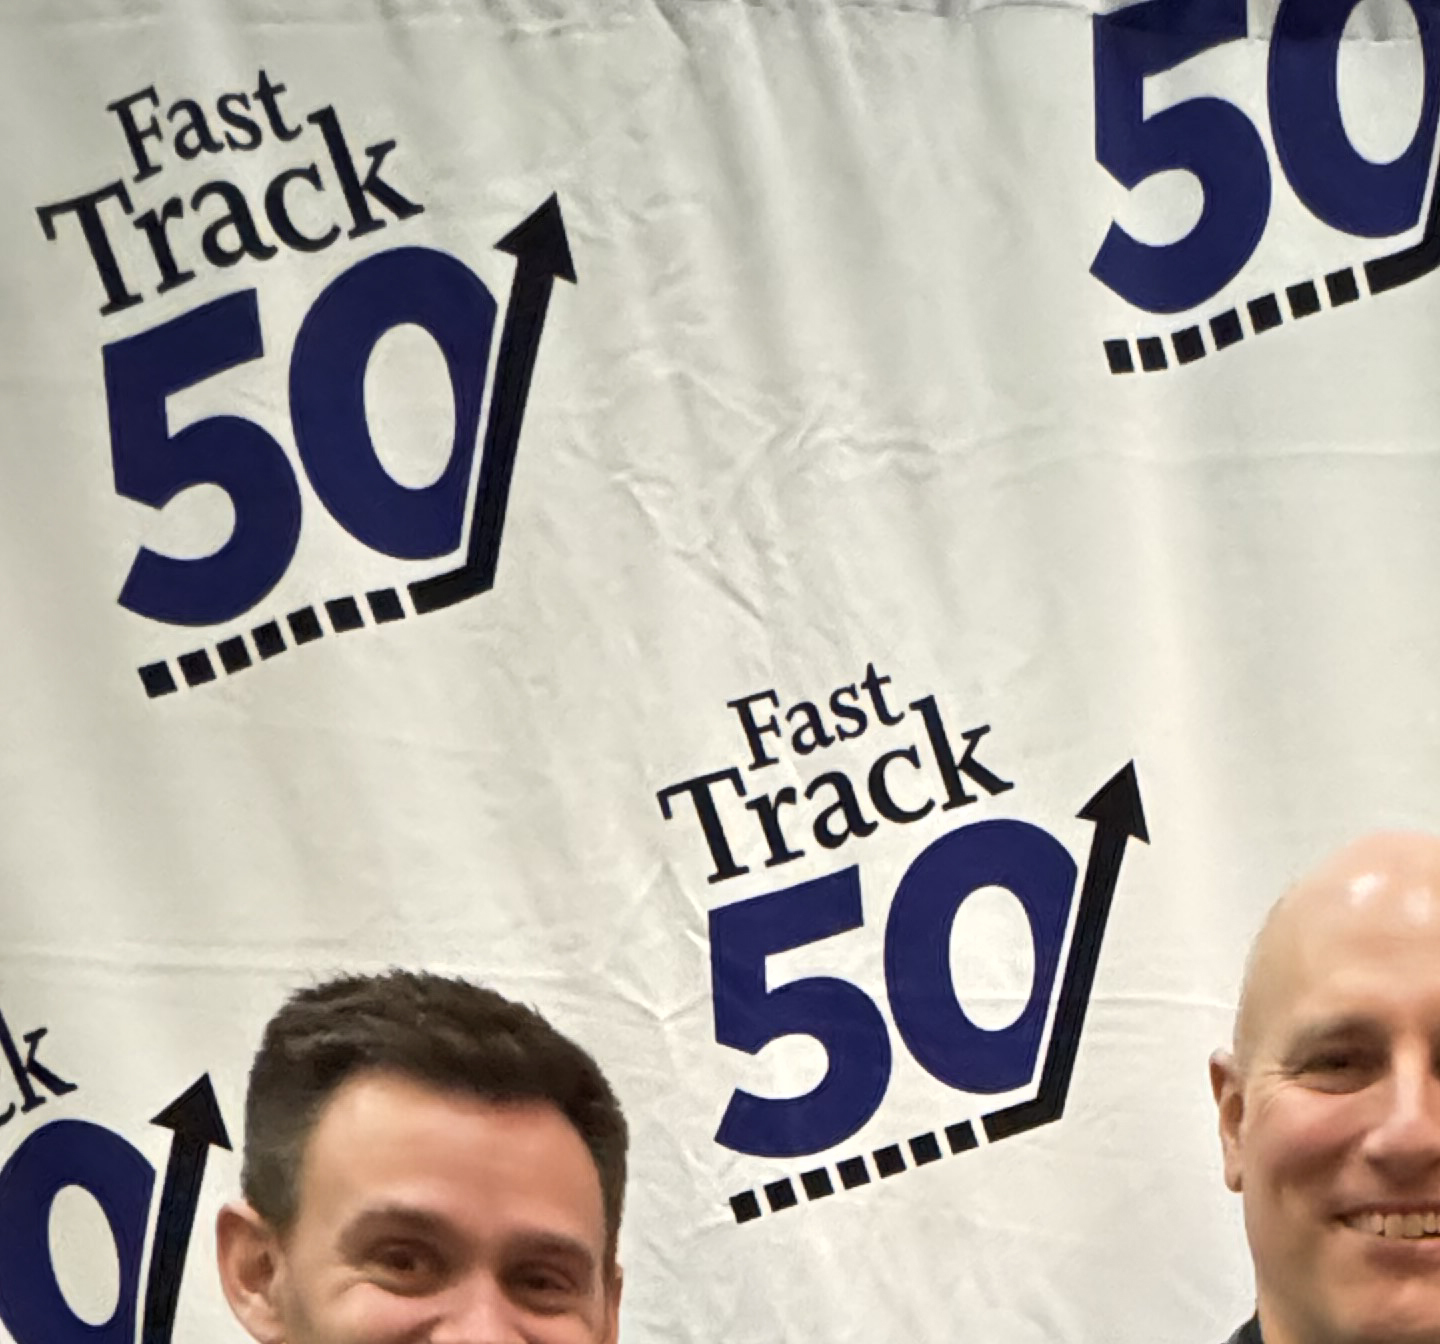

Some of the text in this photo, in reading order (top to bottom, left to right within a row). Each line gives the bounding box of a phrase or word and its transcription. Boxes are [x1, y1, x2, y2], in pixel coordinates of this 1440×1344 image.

[35, 105, 425, 316] Track
[107, 69, 303, 183] Fast
[102, 245, 498, 627] 50
[656, 694, 1015, 884] Track
[727, 662, 905, 771] Fast
[708, 818, 1078, 1158] 50
